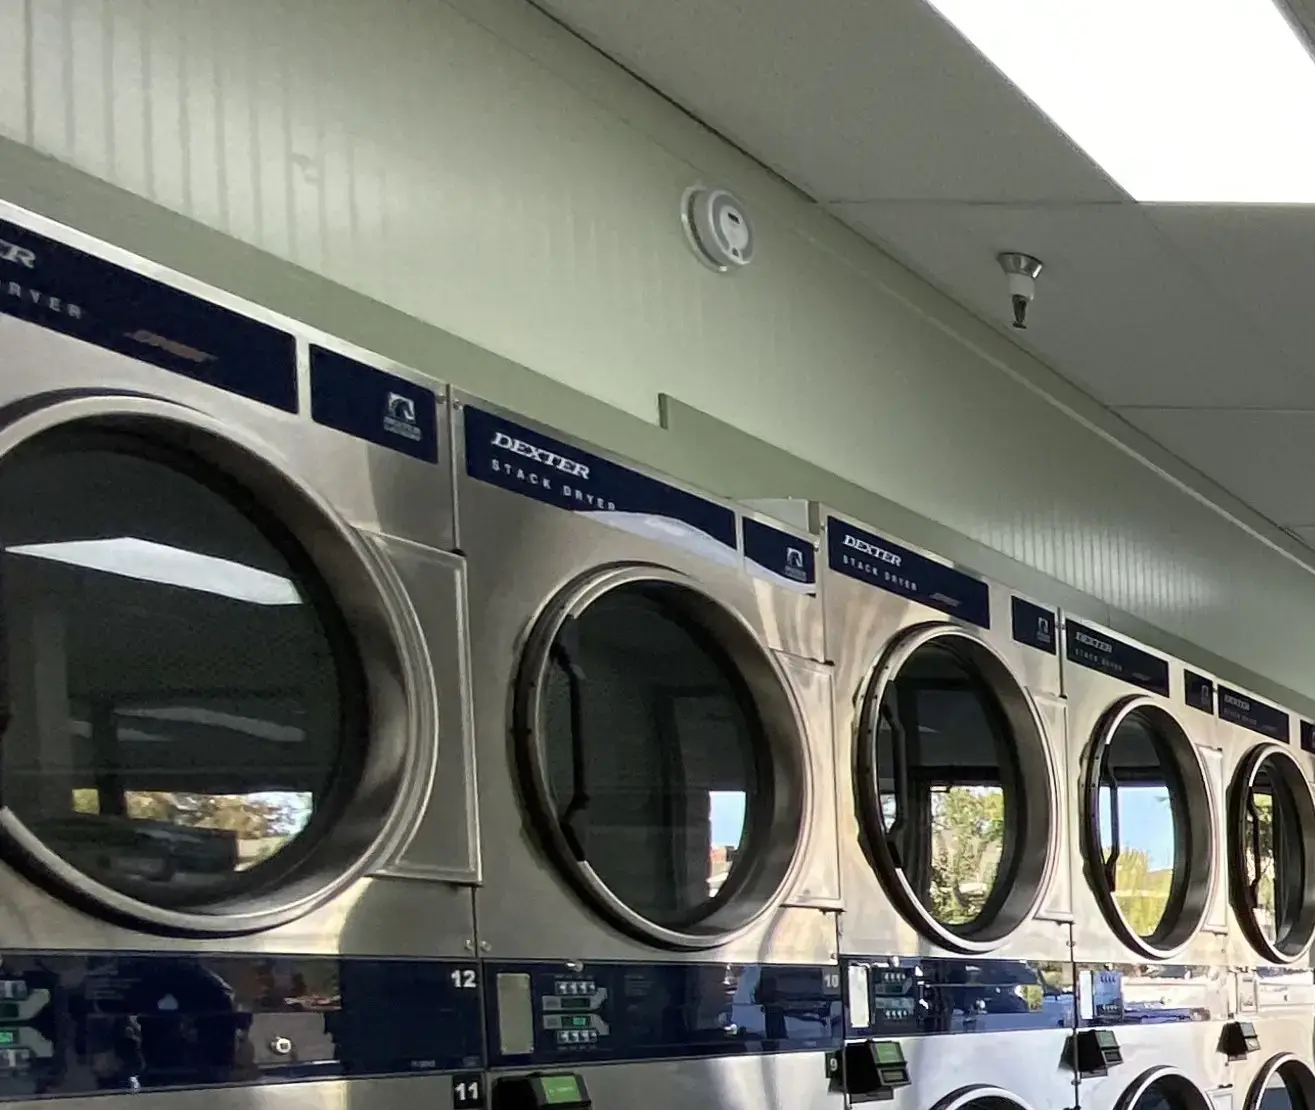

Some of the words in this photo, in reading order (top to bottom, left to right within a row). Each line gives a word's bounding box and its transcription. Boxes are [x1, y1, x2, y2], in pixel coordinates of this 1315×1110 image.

[4, 280, 81, 319] RYER
[491, 432, 591, 480] DEXTER
[492, 459, 552, 489] STACK
[563, 485, 617, 510] DRYER
[843, 534, 902, 567] DEXTER
[843, 554, 878, 576] STACK
[451, 970, 477, 988] 12
[824, 974, 839, 988] 10
[829, 1058, 838, 1072] 9
[455, 1082, 479, 1100] 11
